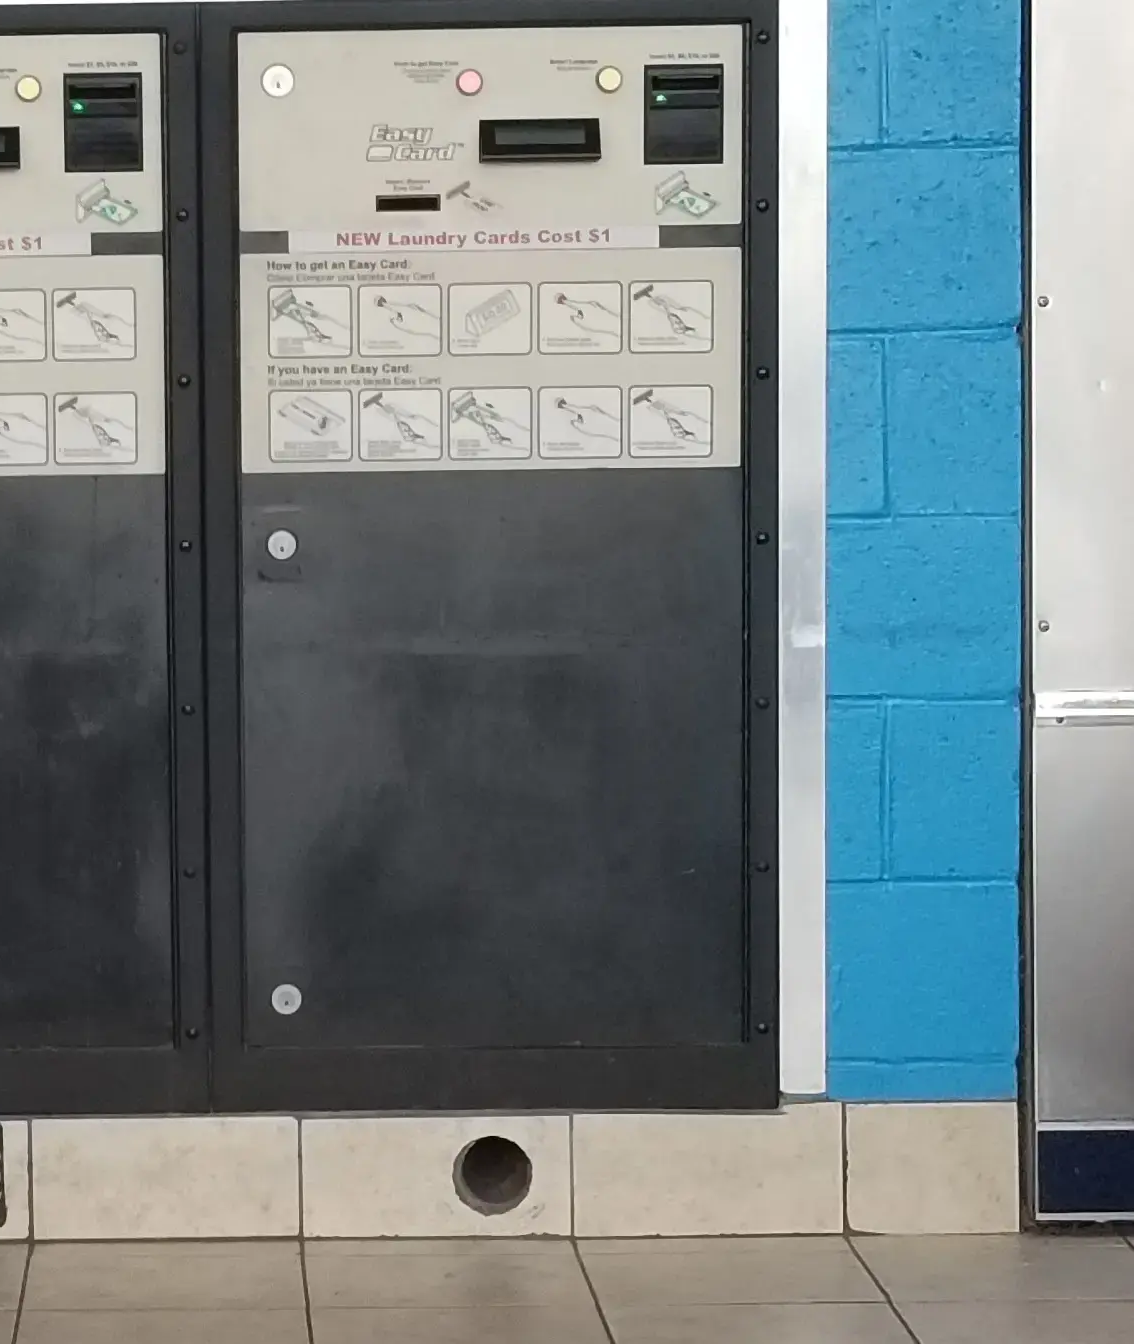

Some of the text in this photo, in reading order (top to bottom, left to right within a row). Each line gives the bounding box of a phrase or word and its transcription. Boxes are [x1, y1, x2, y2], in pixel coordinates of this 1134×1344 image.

[369, 124, 433, 146] Easy
[394, 142, 456, 161] Card
[21, 236, 43, 250] $1
[336, 228, 610, 248] NEW Laundry Cards Cost $1
[267, 261, 291, 271] How
[295, 261, 307, 270] to
[309, 260, 328, 272] get
[331, 261, 345, 269] an
[348, 260, 376, 271] Easy
[388, 272, 410, 282] Easy
[412, 272, 435, 281] Card
[267, 366, 274, 374] If
[277, 366, 299, 377] you
[302, 365, 330, 374] have
[333, 366, 347, 374] an
[350, 364, 378, 375] Easy
